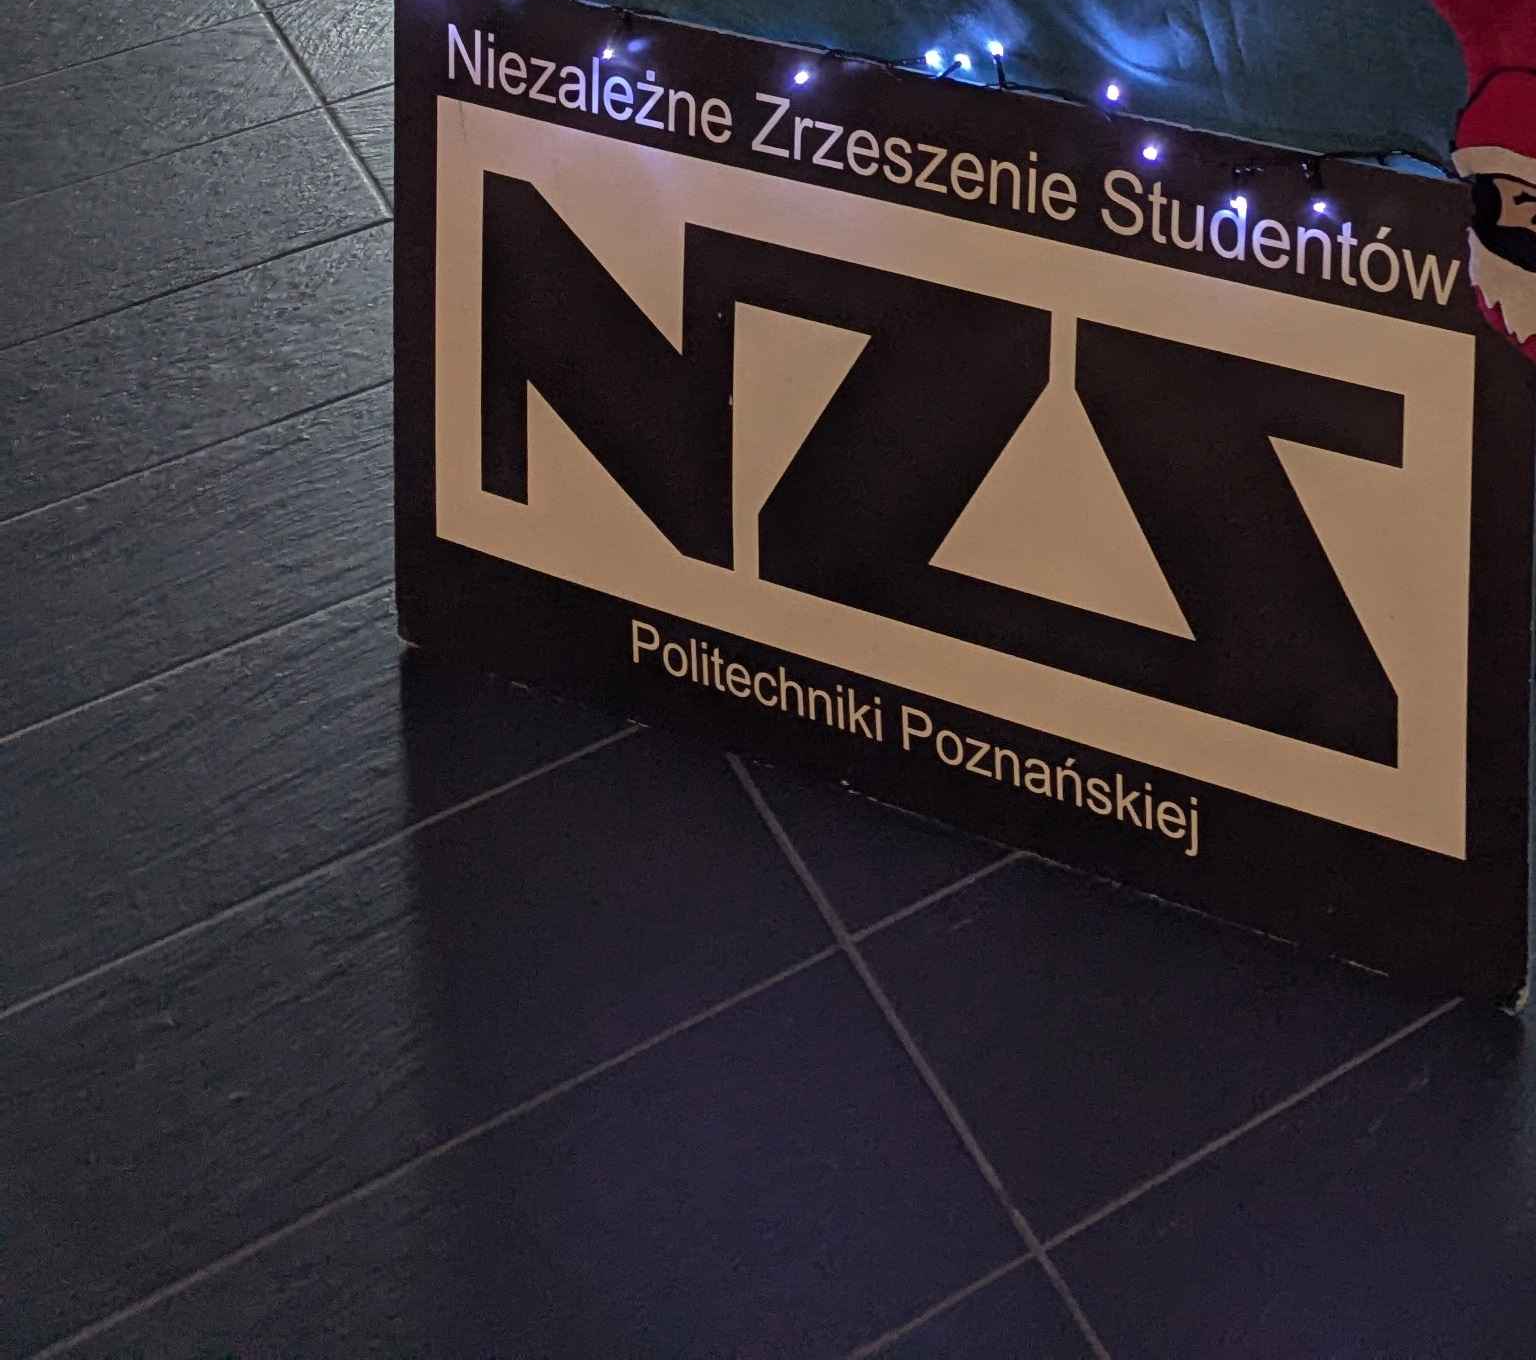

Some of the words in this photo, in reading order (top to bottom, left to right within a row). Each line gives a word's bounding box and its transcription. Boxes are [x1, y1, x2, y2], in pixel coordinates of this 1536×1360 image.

[446, 23, 734, 145] Niezależne
[751, 93, 1080, 224] Zrzeszenie
[1101, 168, 1462, 308] Studentów
[481, 170, 1404, 769] NZS
[630, 619, 885, 743] Politechniki
[901, 704, 1202, 858] Poznańskiej
